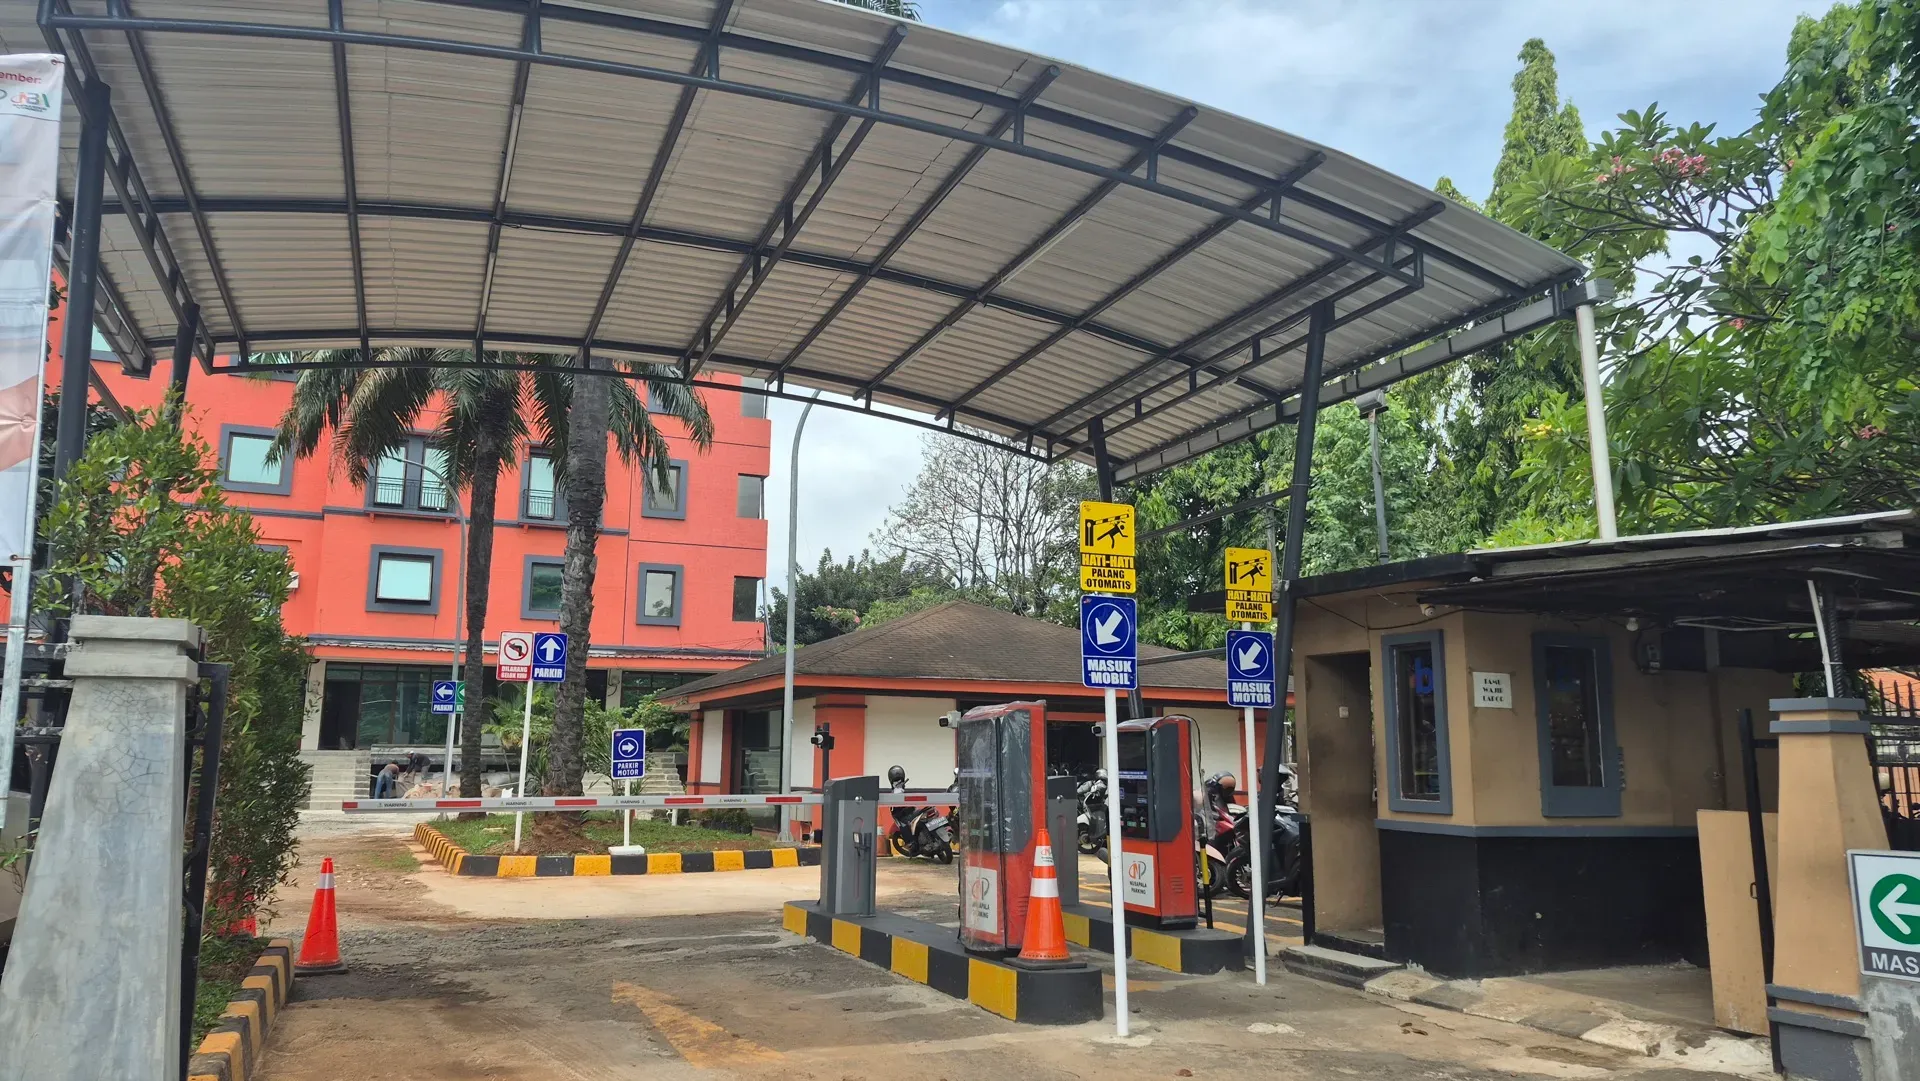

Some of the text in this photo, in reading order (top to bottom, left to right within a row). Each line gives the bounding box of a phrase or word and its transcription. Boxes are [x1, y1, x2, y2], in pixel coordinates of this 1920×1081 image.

[1081, 553, 1134, 569] HATI-HATI
[1091, 568, 1125, 579] PALANG
[1086, 578, 1131, 590] OTOMATIS
[1227, 590, 1271, 603] HATI-HATI
[1235, 602, 1263, 611] PALANG
[1231, 610, 1268, 620] OTOMATIS
[501, 665, 528, 673] DILARANG
[1087, 659, 1132, 673] MASUK
[533, 667, 563, 679] PARKIR
[1090, 671, 1131, 685] MOBIL
[1231, 682, 1271, 693] MASUK
[1233, 692, 1272, 704] MOTOR
[433, 704, 454, 712] PARKIR
[617, 762, 639, 770] PARKIR
[617, 768, 639, 777] MOTOR
[1870, 952, 1920, 976] MAS
